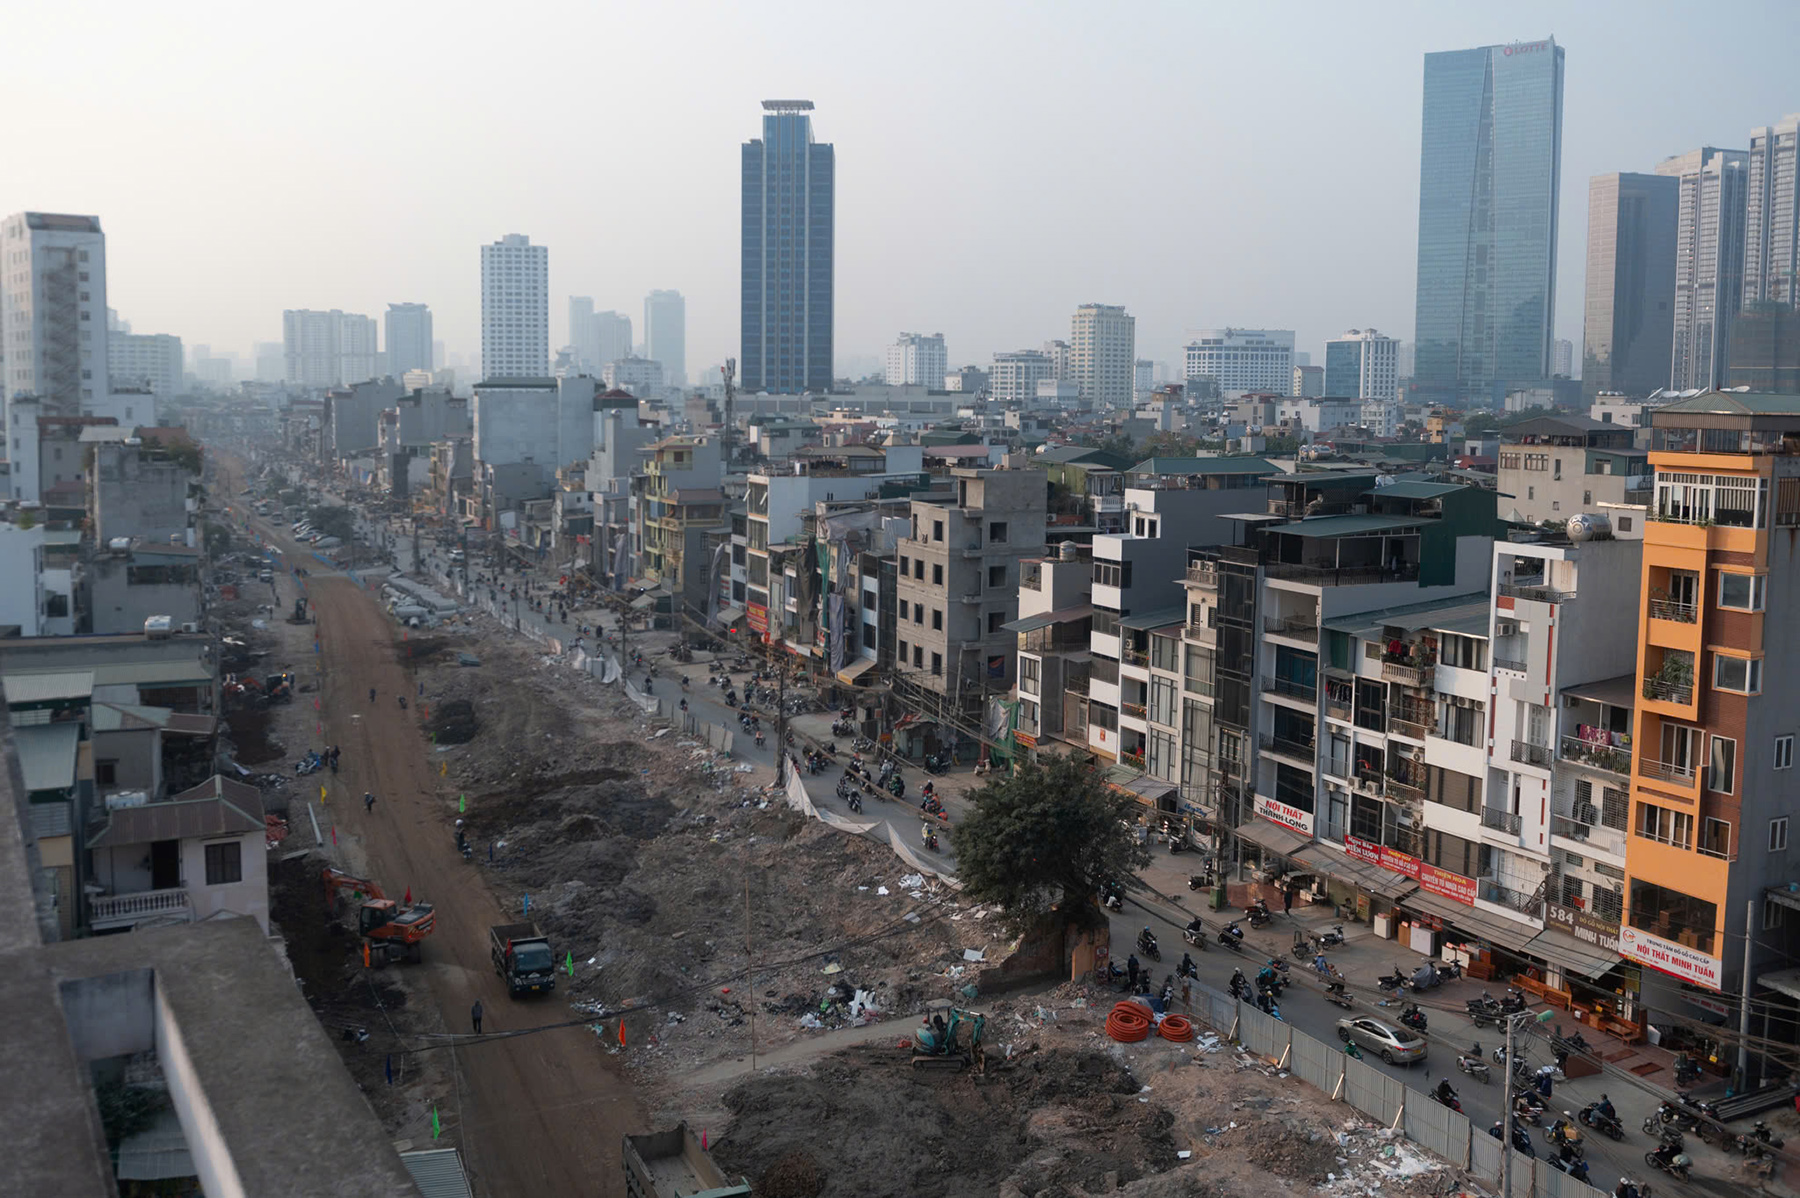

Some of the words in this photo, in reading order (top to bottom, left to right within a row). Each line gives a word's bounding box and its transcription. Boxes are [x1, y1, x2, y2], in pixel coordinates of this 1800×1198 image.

[1266, 800, 1281, 812] NỘI
[1282, 805, 1304, 821] THẤT
[1285, 817, 1308, 831] LONG
[1550, 906, 1574, 925] 584
[1575, 926, 1597, 943] MINH
[1636, 943, 1650, 957] NỘI
[1651, 948, 1670, 963] THẤT
[1671, 956, 1693, 972] MINH
[1693, 964, 1715, 980] TUẤN
[1646, 938, 1663, 949] TRUNG
[1663, 943, 1674, 952] TÂM
[1673, 947, 1682, 955] ĐỒ
[1681, 950, 1690, 958] GỖ
[1689, 953, 1700, 962] CAO
[1699, 956, 1710, 965] CẤP
